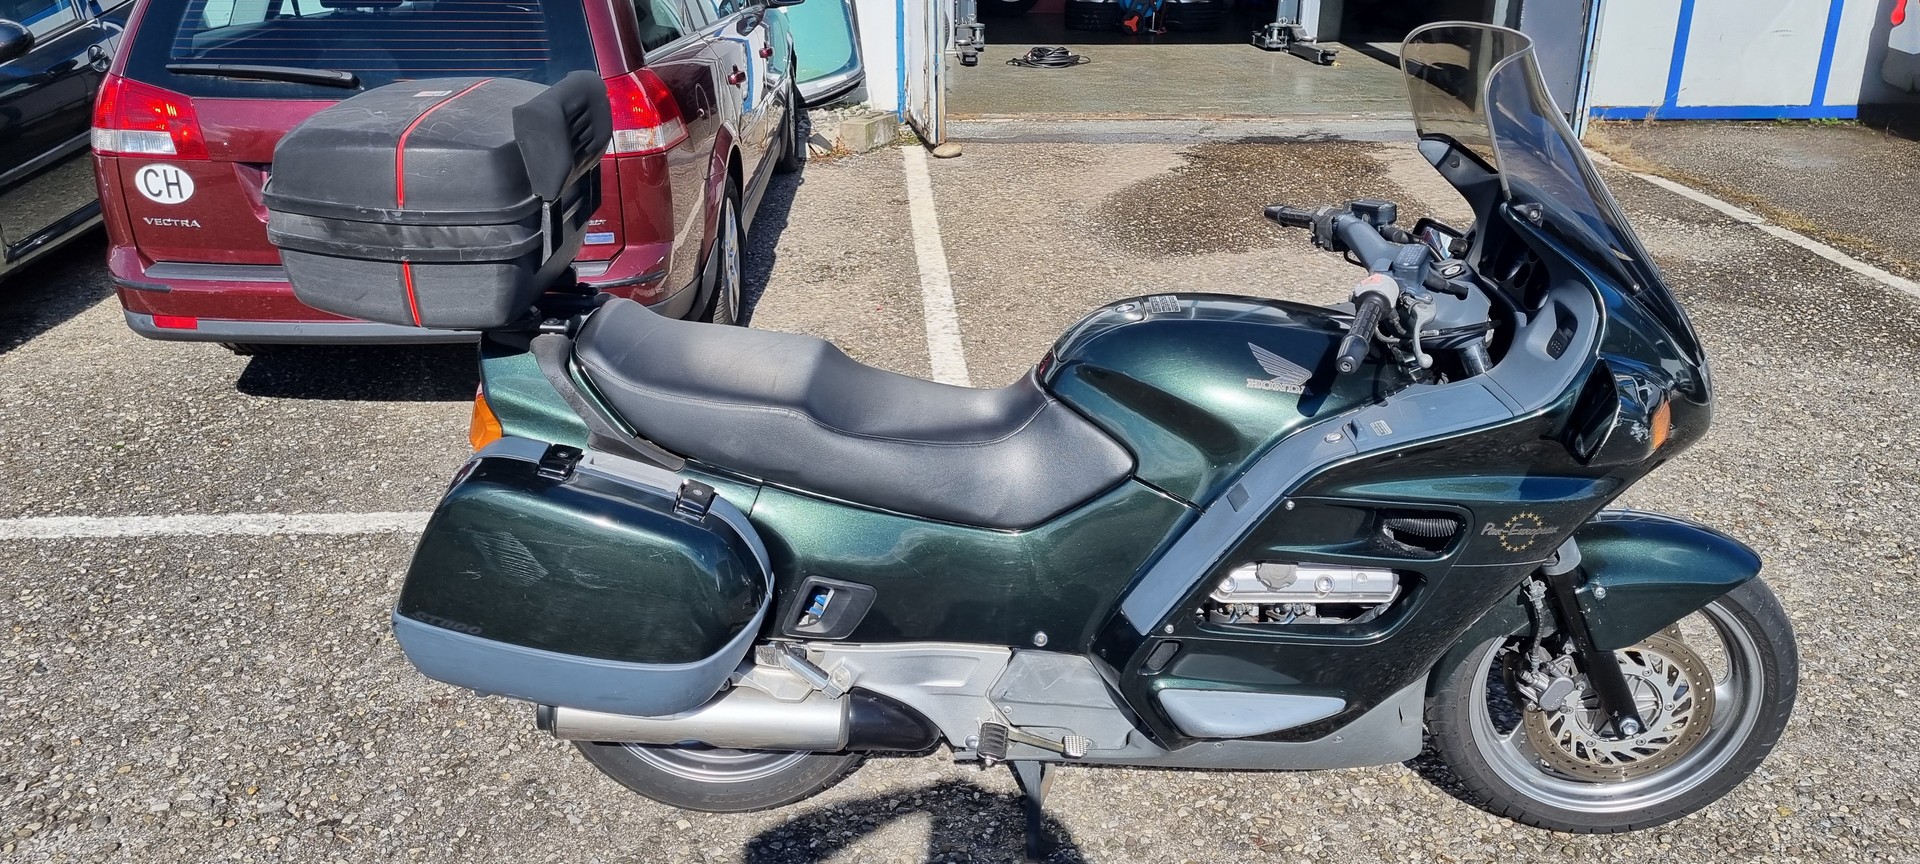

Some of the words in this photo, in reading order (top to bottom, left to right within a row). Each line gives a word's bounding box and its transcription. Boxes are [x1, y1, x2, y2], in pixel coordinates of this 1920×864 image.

[143, 168, 184, 198] CH
[142, 217, 201, 228] VECTRA
[1246, 378, 1314, 396] HONDA
[1480, 522, 1559, 539] Pan-European
